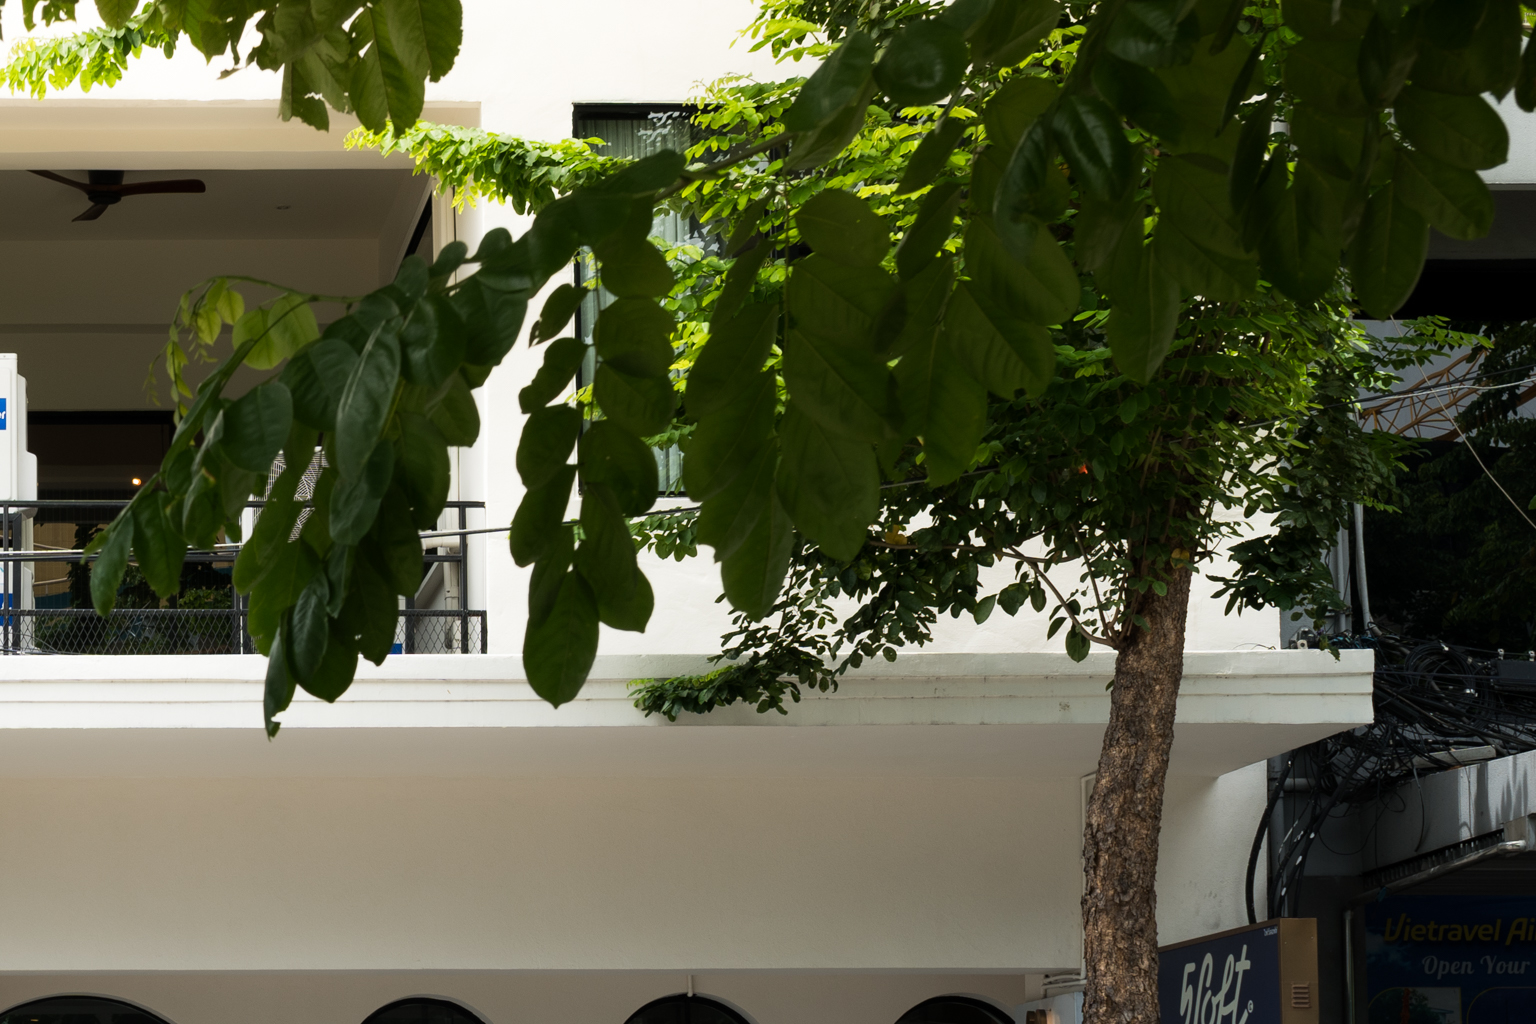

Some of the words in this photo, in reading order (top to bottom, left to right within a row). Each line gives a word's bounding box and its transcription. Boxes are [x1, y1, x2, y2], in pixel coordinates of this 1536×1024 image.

[1384, 912, 1503, 944] Vietravel
[1504, 917, 1536, 946] Ai
[1421, 955, 1475, 980] Open
[1480, 955, 1531, 975] Your
